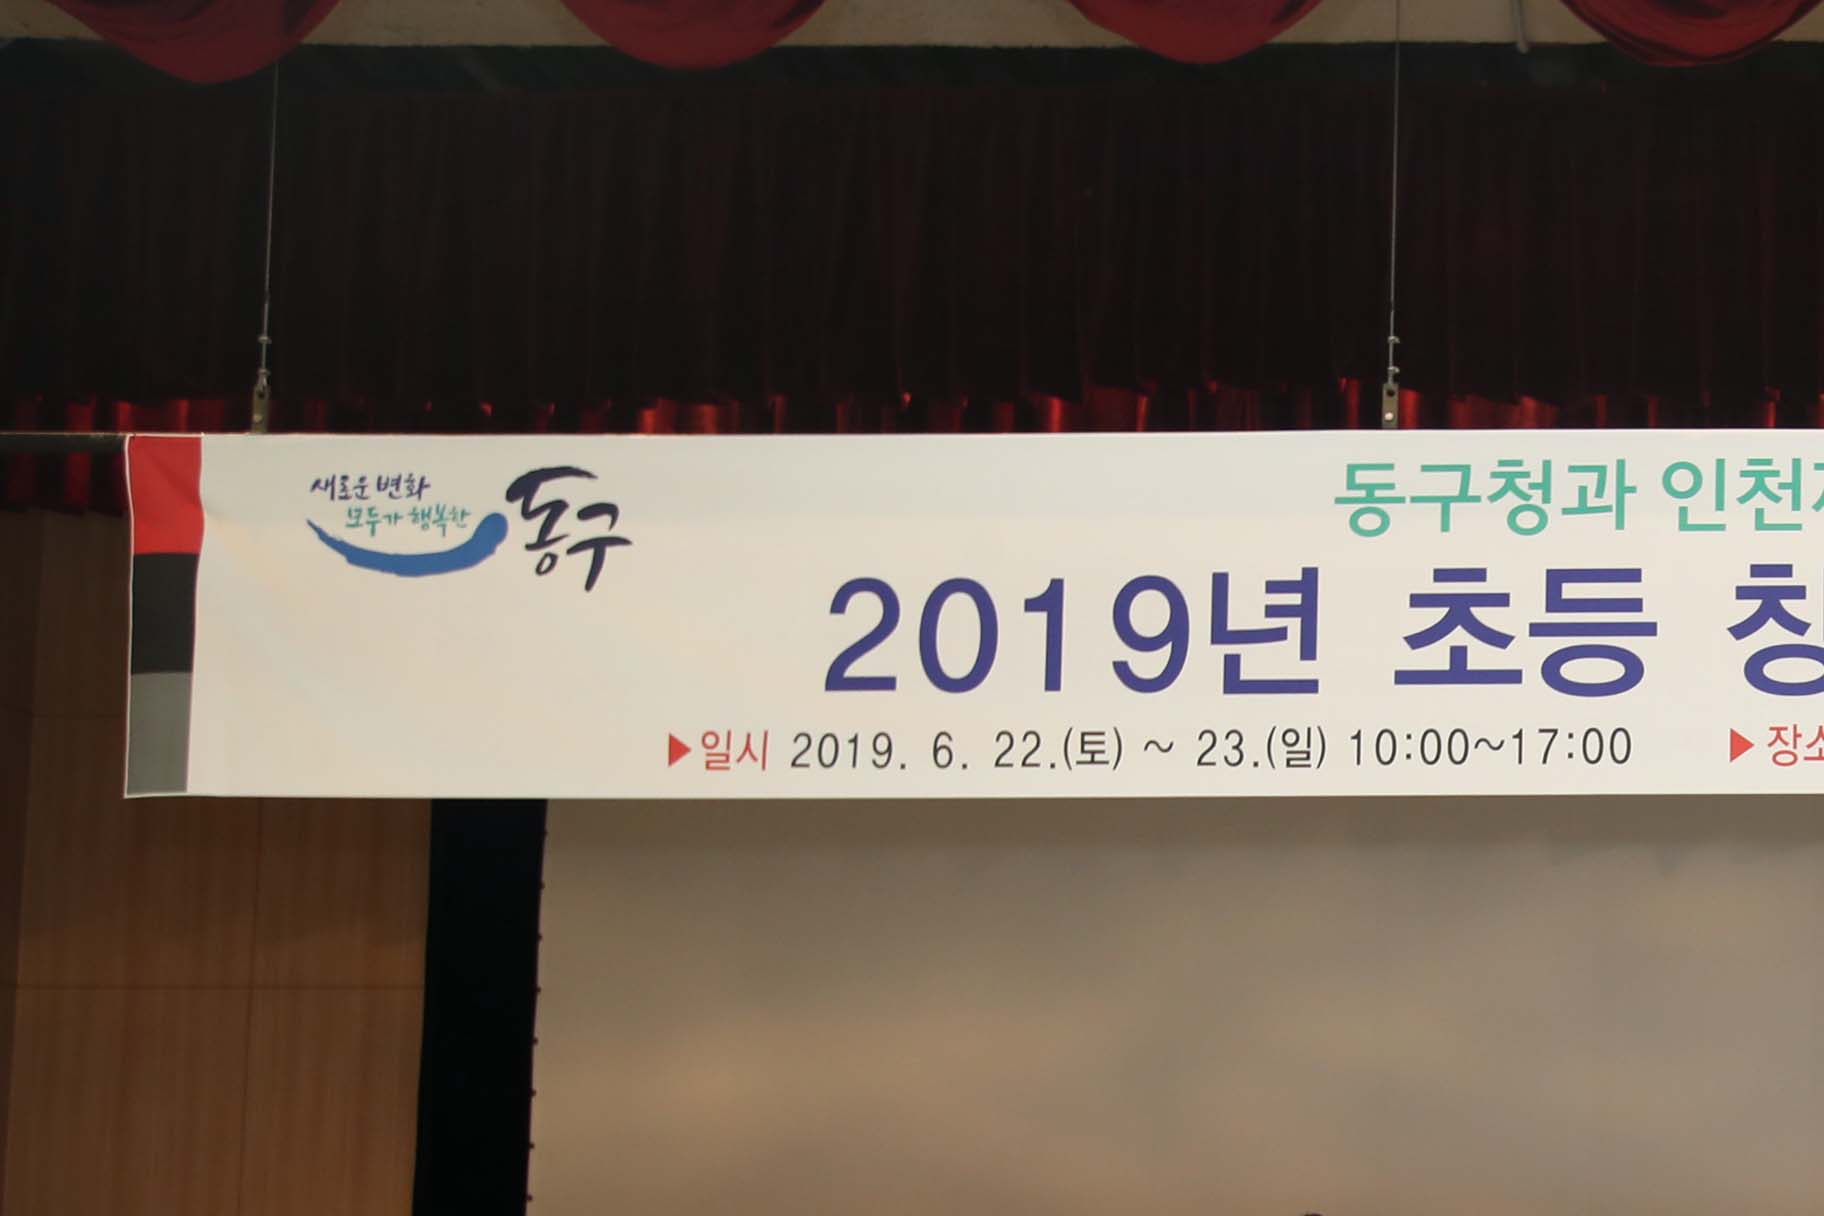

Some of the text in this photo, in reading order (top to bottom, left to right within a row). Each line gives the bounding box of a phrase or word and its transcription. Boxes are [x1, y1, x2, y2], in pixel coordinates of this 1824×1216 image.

[310, 473, 431, 502] 새로운 변화
[1333, 458, 1638, 538] 동구청과
[345, 502, 472, 537] 모두가 행복한
[505, 464, 633, 593] 동구
[823, 566, 1320, 697] 2019년
[1393, 566, 1660, 698] 초등
[700, 729, 769, 772] 일시
[790, 731, 907, 771] 2019.
[932, 730, 969, 771] 6.
[993, 726, 1124, 772] 22.(토)
[1196, 725, 1328, 771] 23.(일)
[1349, 726, 1632, 768] 10:00~17:00
